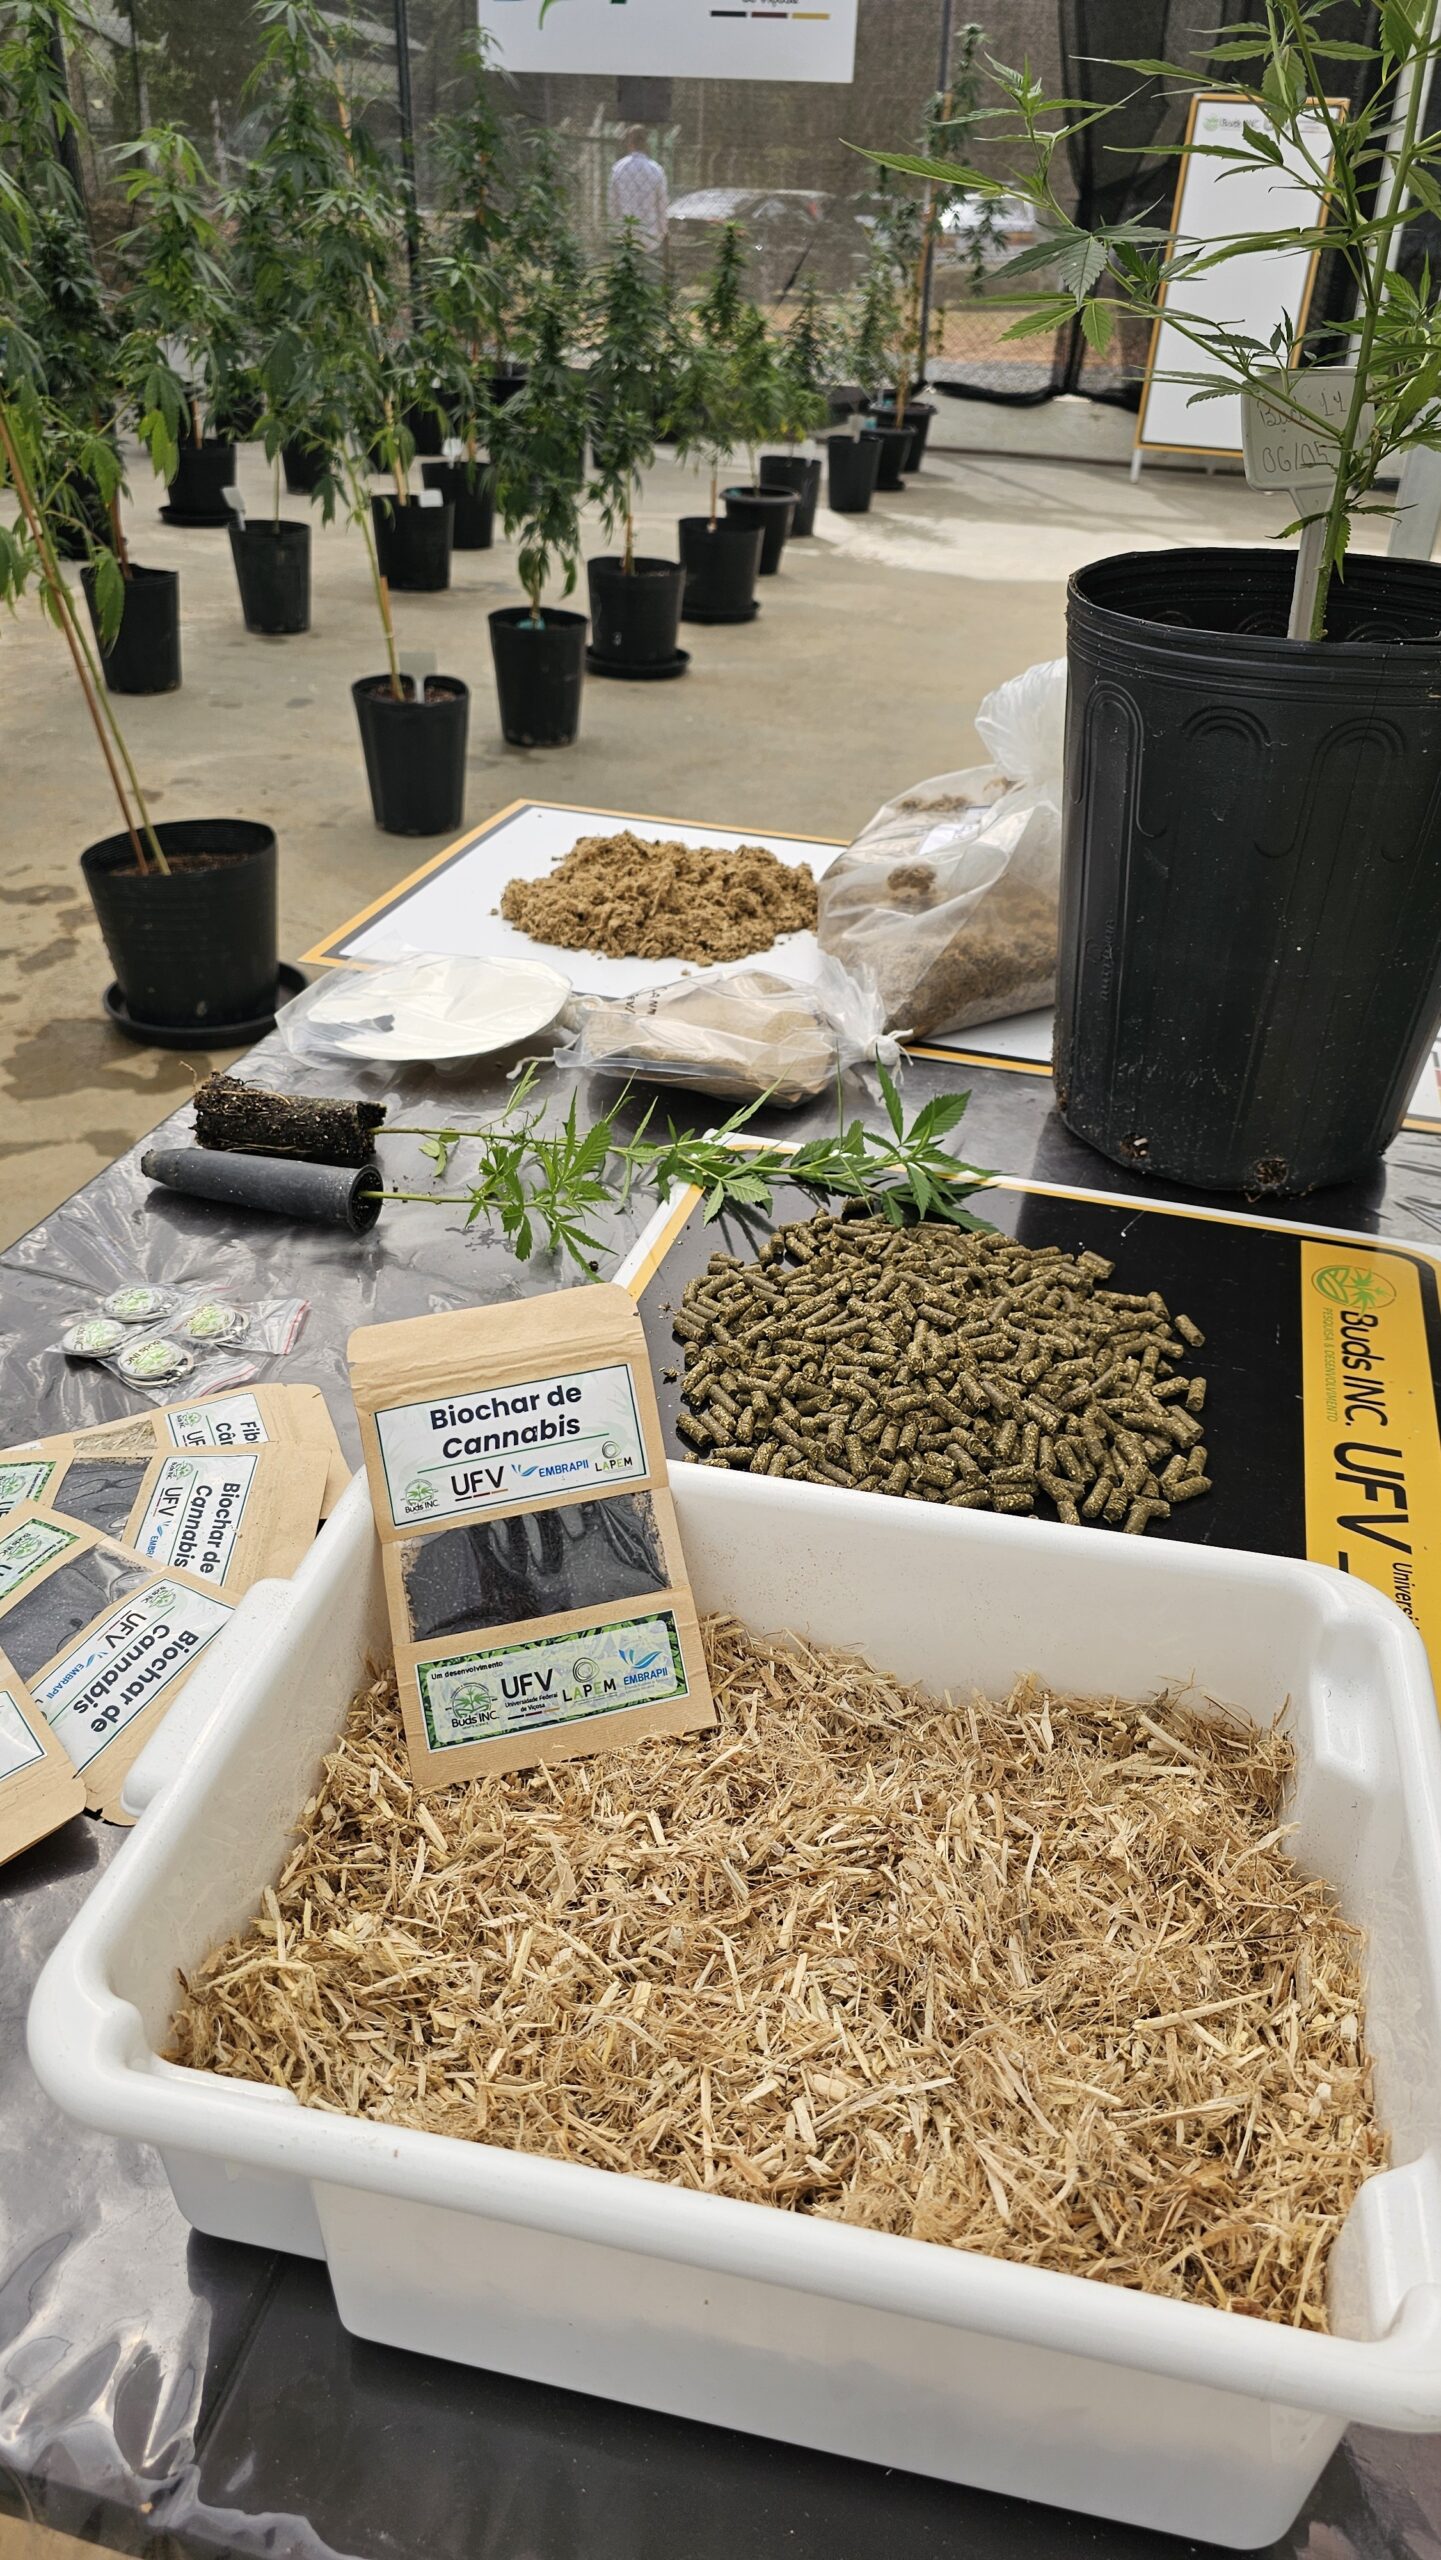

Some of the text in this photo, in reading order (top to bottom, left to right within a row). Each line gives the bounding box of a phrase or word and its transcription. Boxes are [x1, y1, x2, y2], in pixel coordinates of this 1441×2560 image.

[1323, 1307, 1334, 1340] PESQUISA
[1340, 1310, 1388, 1427] Buds INC.
[1324, 1350, 1338, 1422] DESENVOLVIMENTO
[430, 1385, 582, 1430] Biochar de
[240, 1421, 260, 1444] Fib
[442, 1415, 581, 1459] Cannabis
[538, 1459, 589, 1478] EMBRAPII
[595, 1456, 633, 1472] LAPEM
[451, 1465, 504, 1496] UFV
[158, 1487, 183, 1516] UFV
[404, 1503, 424, 1514] Buds
[1334, 1441, 1413, 1555] UFV
[173, 1485, 212, 1567] Cannabis
[200, 1482, 241, 1574] Biochar de
[105, 1612, 147, 1649] UFV
[46, 1663, 85, 1699] EMBRAPII
[73, 1624, 170, 1714] Cannabis
[90, 1630, 200, 1733] Biochar de
[431, 1661, 504, 1680] Um desenvolvimento
[501, 1668, 553, 1699] UFV
[623, 1667, 668, 1686] EMBRAPII
[504, 1691, 558, 1708] Universidade Federal
[562, 1678, 617, 1702] LAPEM
[451, 1714, 478, 1728] Buds
[528, 1703, 546, 1712] Viçosa
